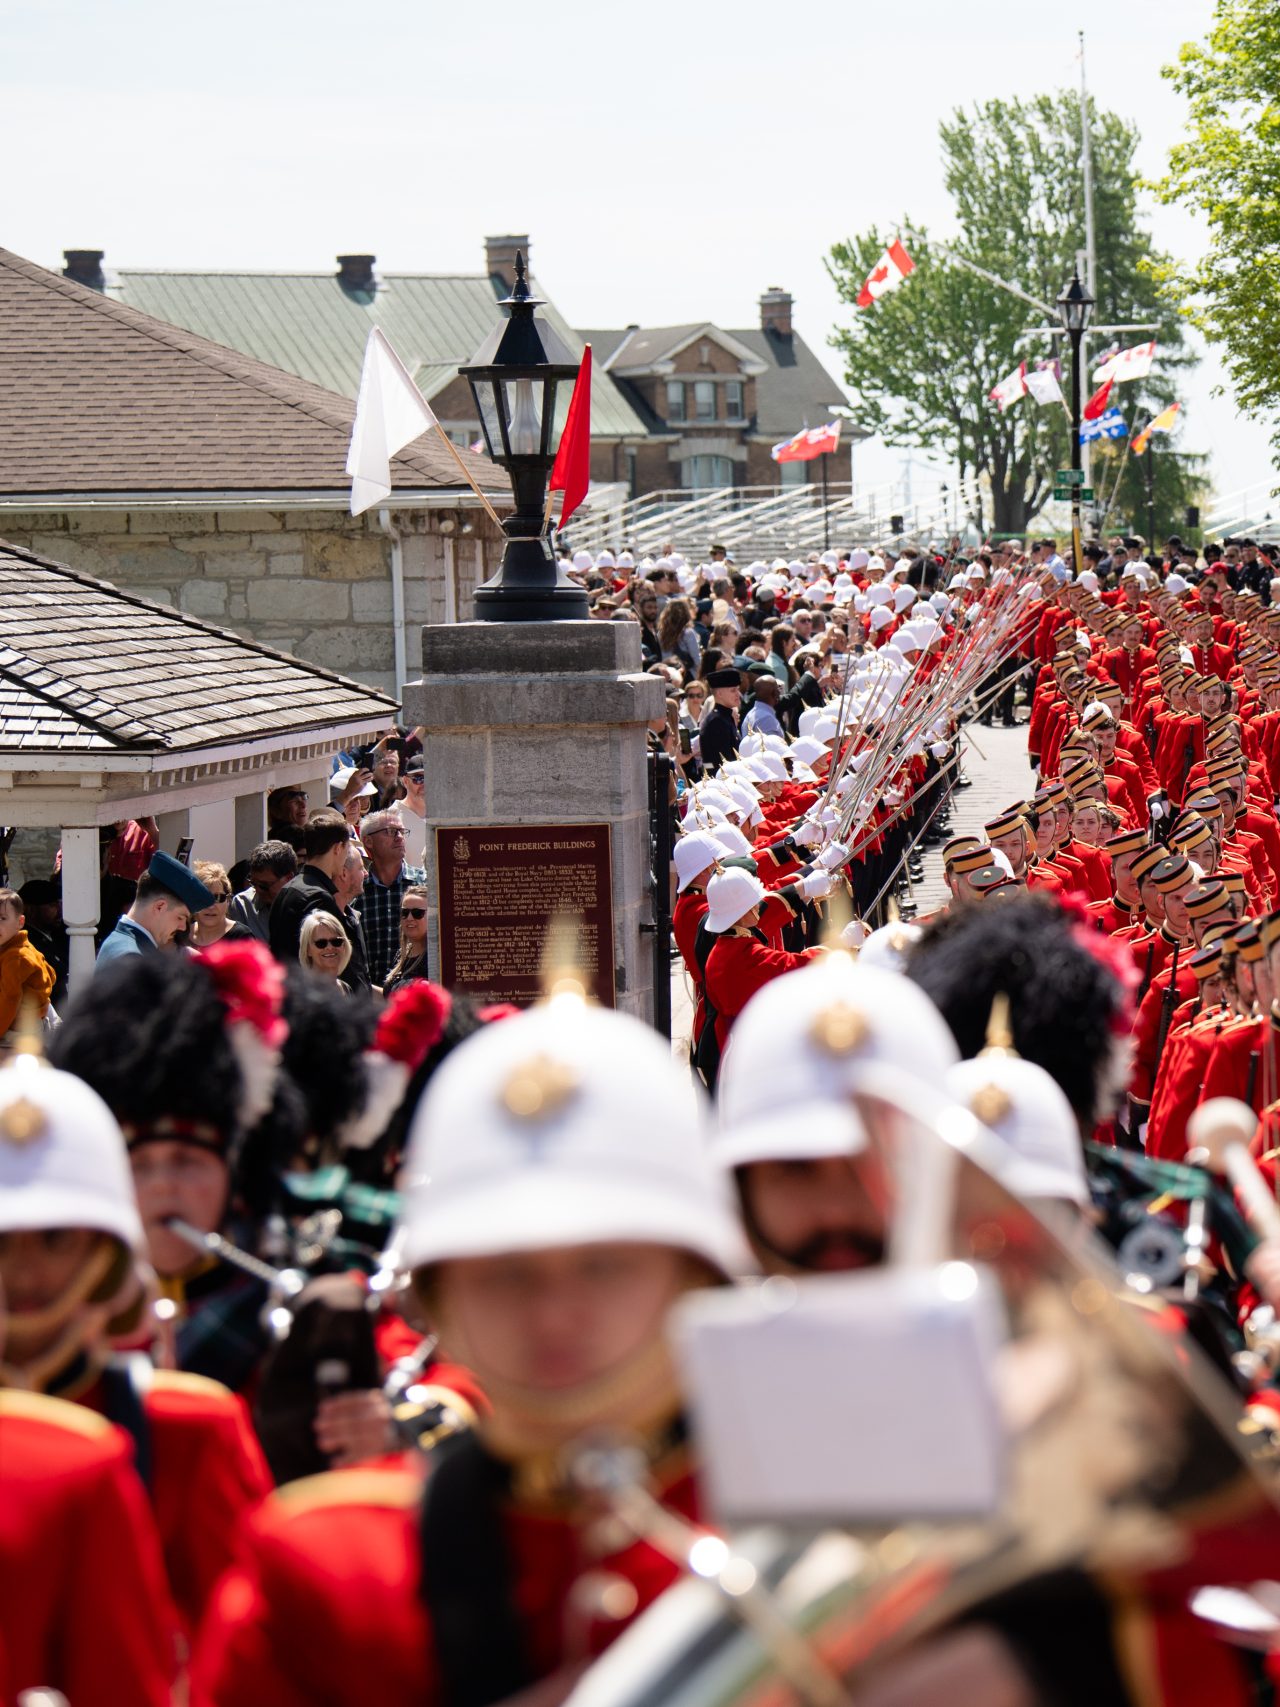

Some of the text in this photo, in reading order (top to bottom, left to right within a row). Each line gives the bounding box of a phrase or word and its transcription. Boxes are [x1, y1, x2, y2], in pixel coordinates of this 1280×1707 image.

[479, 840, 596, 851] POINT FREDERICK BUILDINGS
